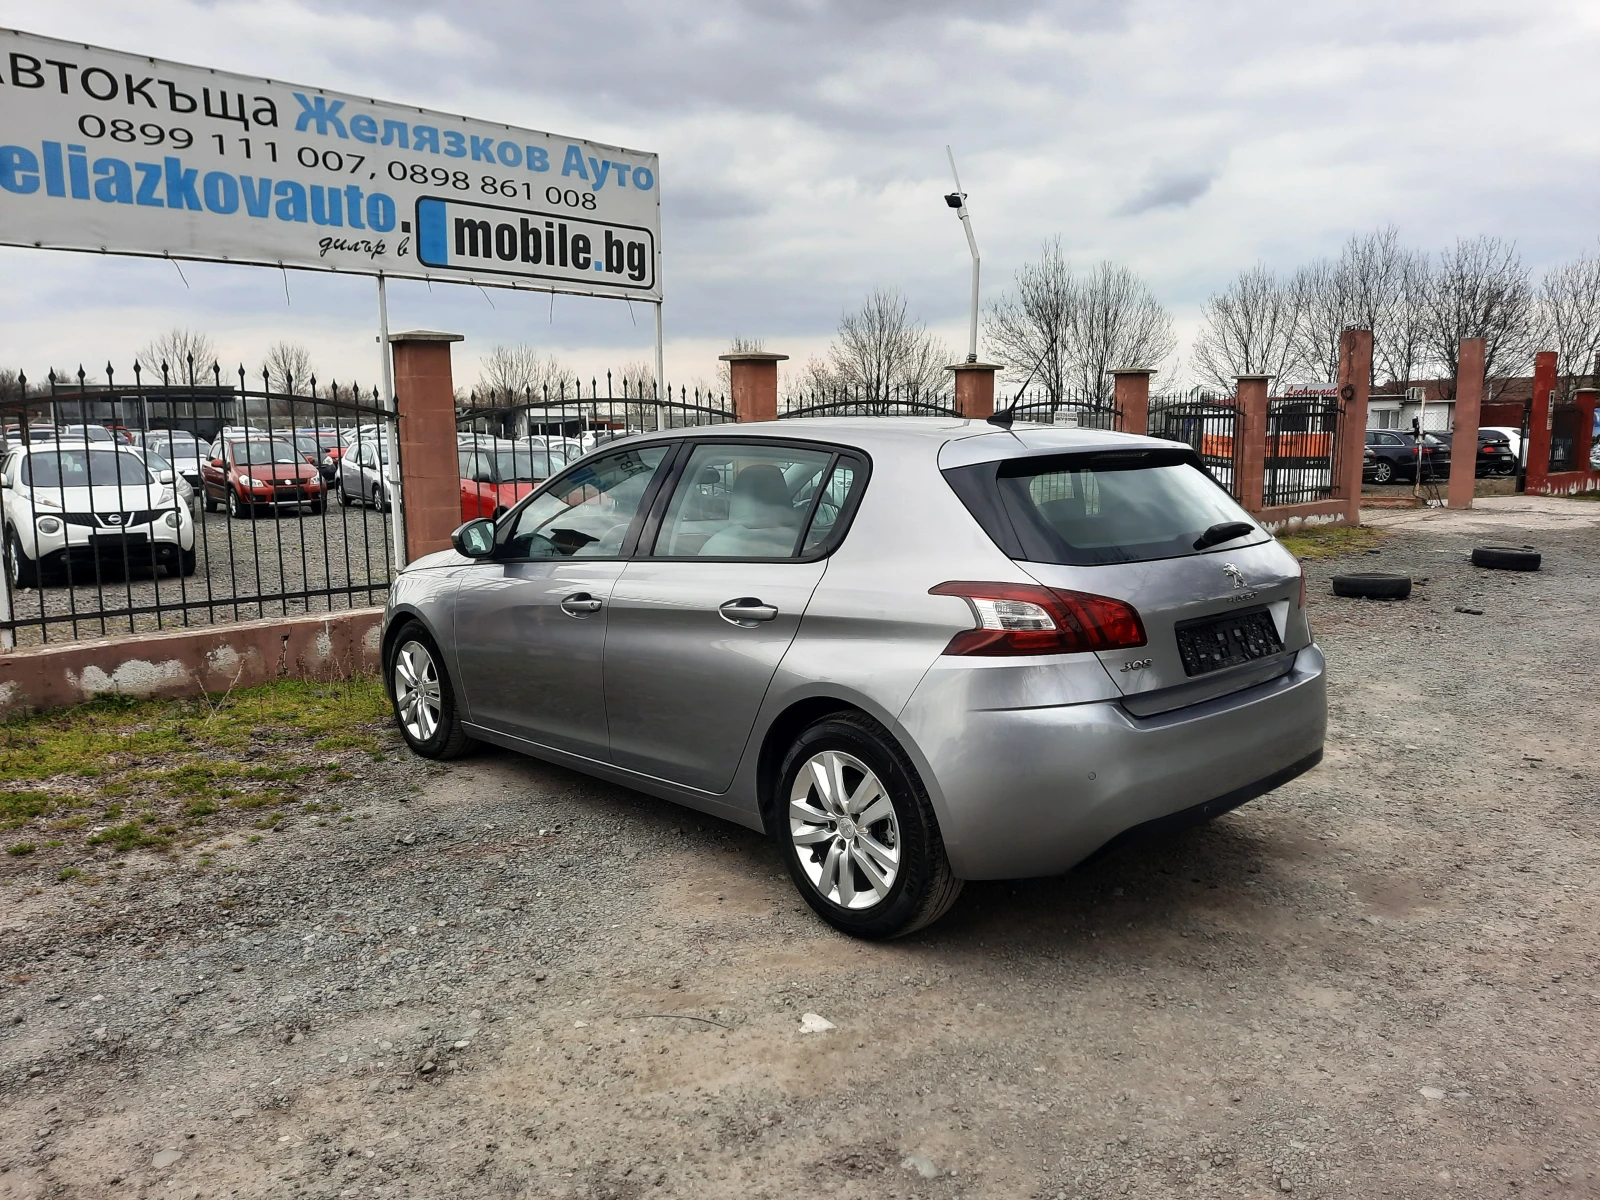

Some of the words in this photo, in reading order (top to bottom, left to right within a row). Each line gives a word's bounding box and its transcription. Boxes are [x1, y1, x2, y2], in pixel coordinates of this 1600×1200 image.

[0, 52, 279, 132] втокъща
[293, 92, 550, 173] Желязков
[561, 144, 654, 192] Ауто
[78, 114, 194, 150] 0899
[212, 134, 277, 163] 111
[297, 146, 376, 180] 007,
[387, 161, 470, 191] 0898
[480, 175, 532, 200] 861
[545, 186, 598, 210] 008
[454, 217, 646, 281] mobile.bg
[1120, 658, 1153, 672] 308
